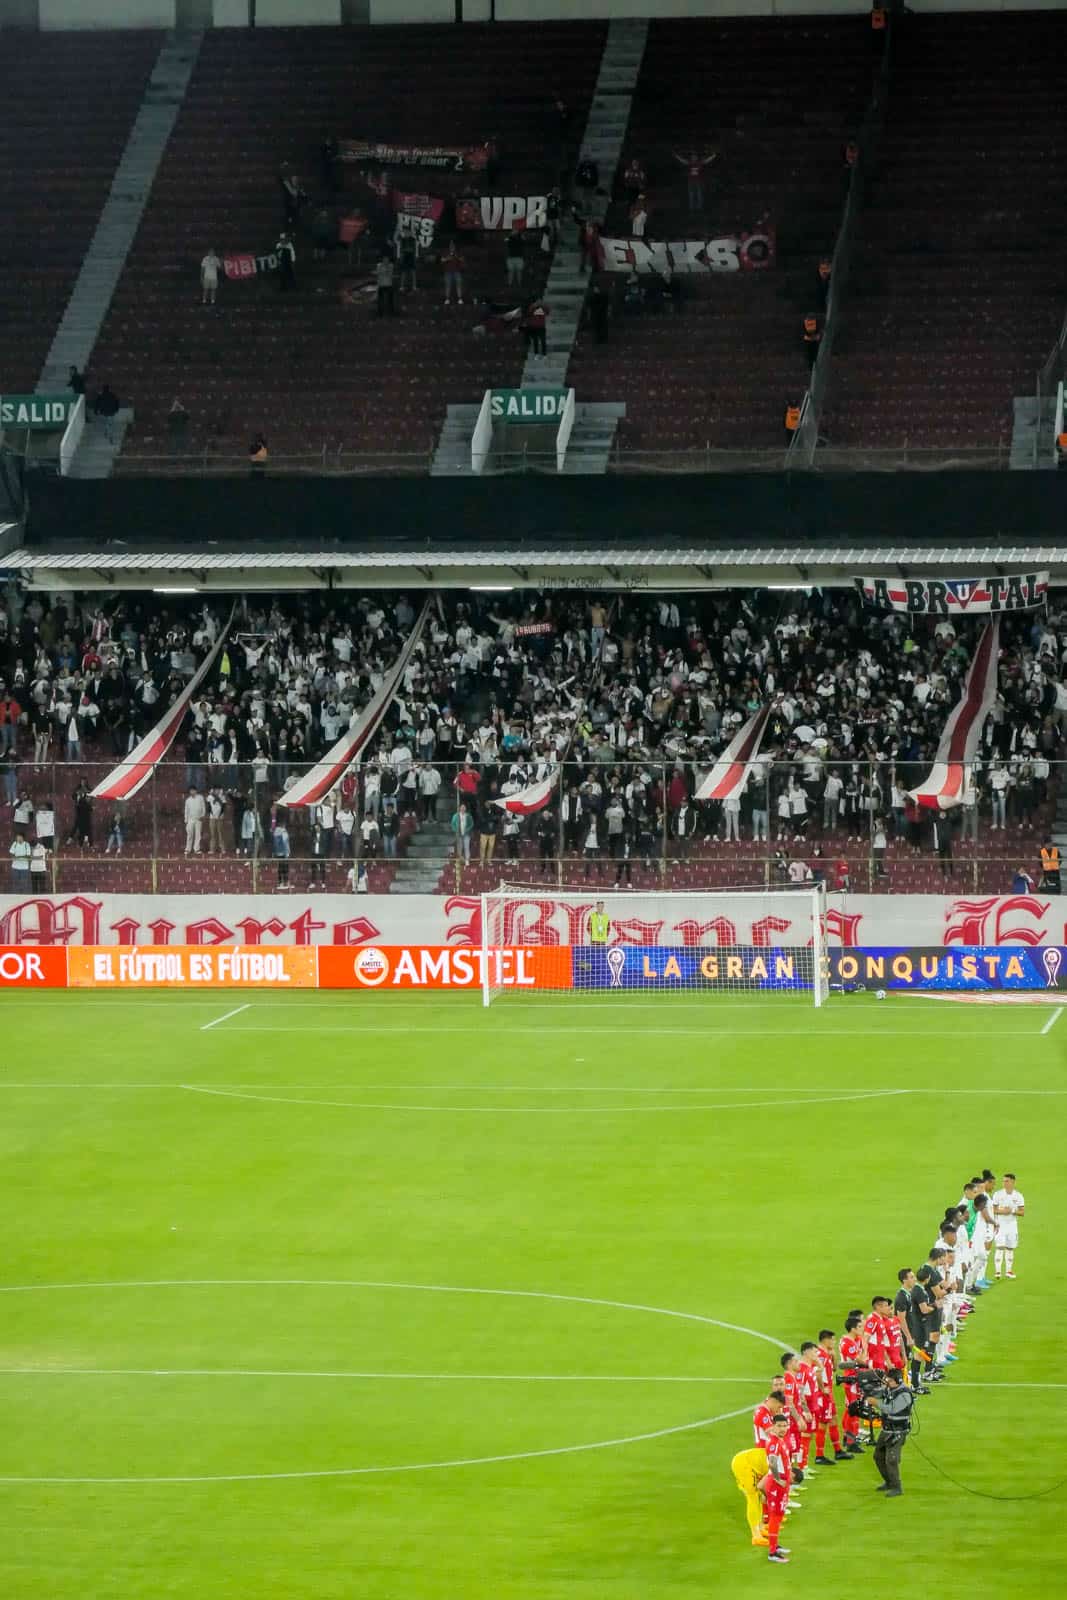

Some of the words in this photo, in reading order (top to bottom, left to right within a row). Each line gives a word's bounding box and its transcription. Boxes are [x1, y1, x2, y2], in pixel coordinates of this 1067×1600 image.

[480, 196, 547, 230] VPR
[93, 954, 114, 980] EL
[119, 946, 185, 981] FÚTBOL
[190, 954, 212, 981] ES
[217, 946, 291, 981] FÚTBOL
[392, 950, 535, 984] AMSTEL
[643, 956, 681, 978] LA
[700, 955, 794, 979] GRAN
